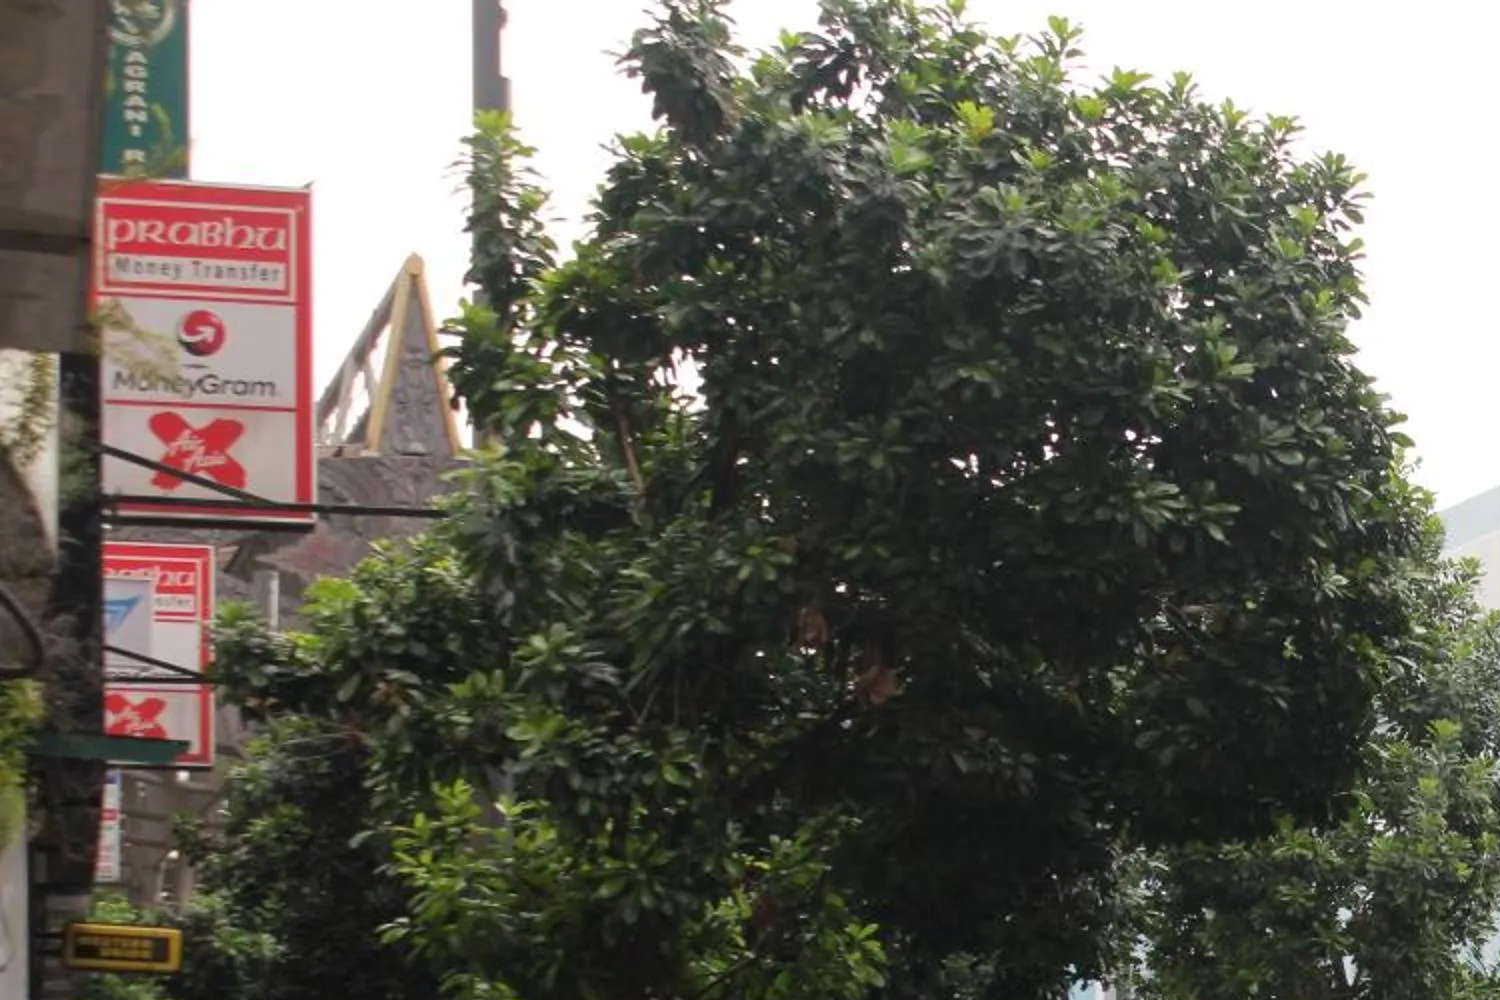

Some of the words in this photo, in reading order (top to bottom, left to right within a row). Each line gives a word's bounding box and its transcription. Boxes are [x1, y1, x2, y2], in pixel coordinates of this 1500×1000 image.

[122, 51, 148, 137] AGRANI
[114, 256, 183, 280] Money
[191, 260, 281, 282] Transfer
[113, 370, 277, 398] MoneyGram
